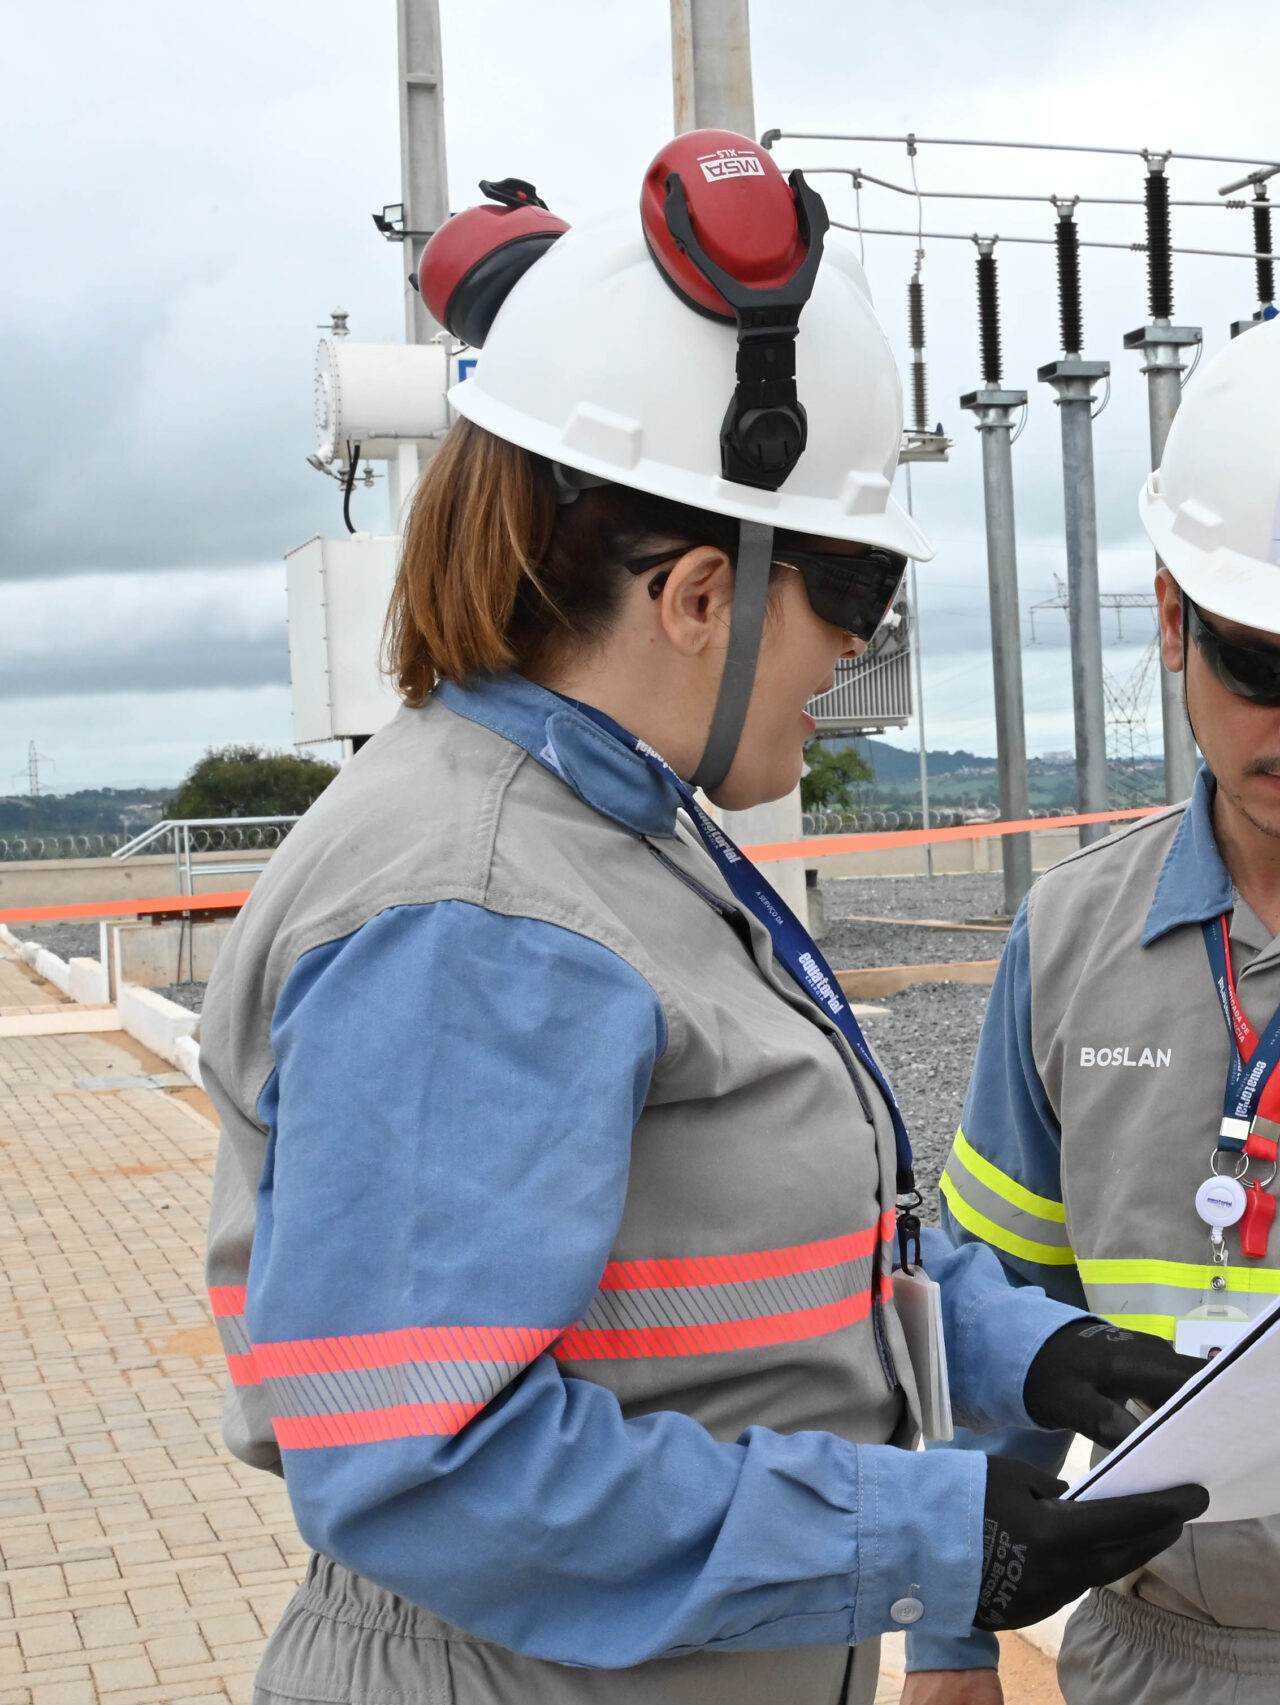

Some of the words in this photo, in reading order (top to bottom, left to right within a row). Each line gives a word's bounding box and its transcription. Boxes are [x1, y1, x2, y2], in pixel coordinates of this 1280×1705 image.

[716, 149, 738, 158] XLS
[705, 160, 759, 177] MSA
[798, 952, 844, 1014] equatorial
[1241, 1023, 1251, 1035] DE
[1080, 1047, 1172, 1068] BOSLAN
[1234, 1060, 1267, 1118] equatorial
[993, 1543, 1028, 1609] VOLK
